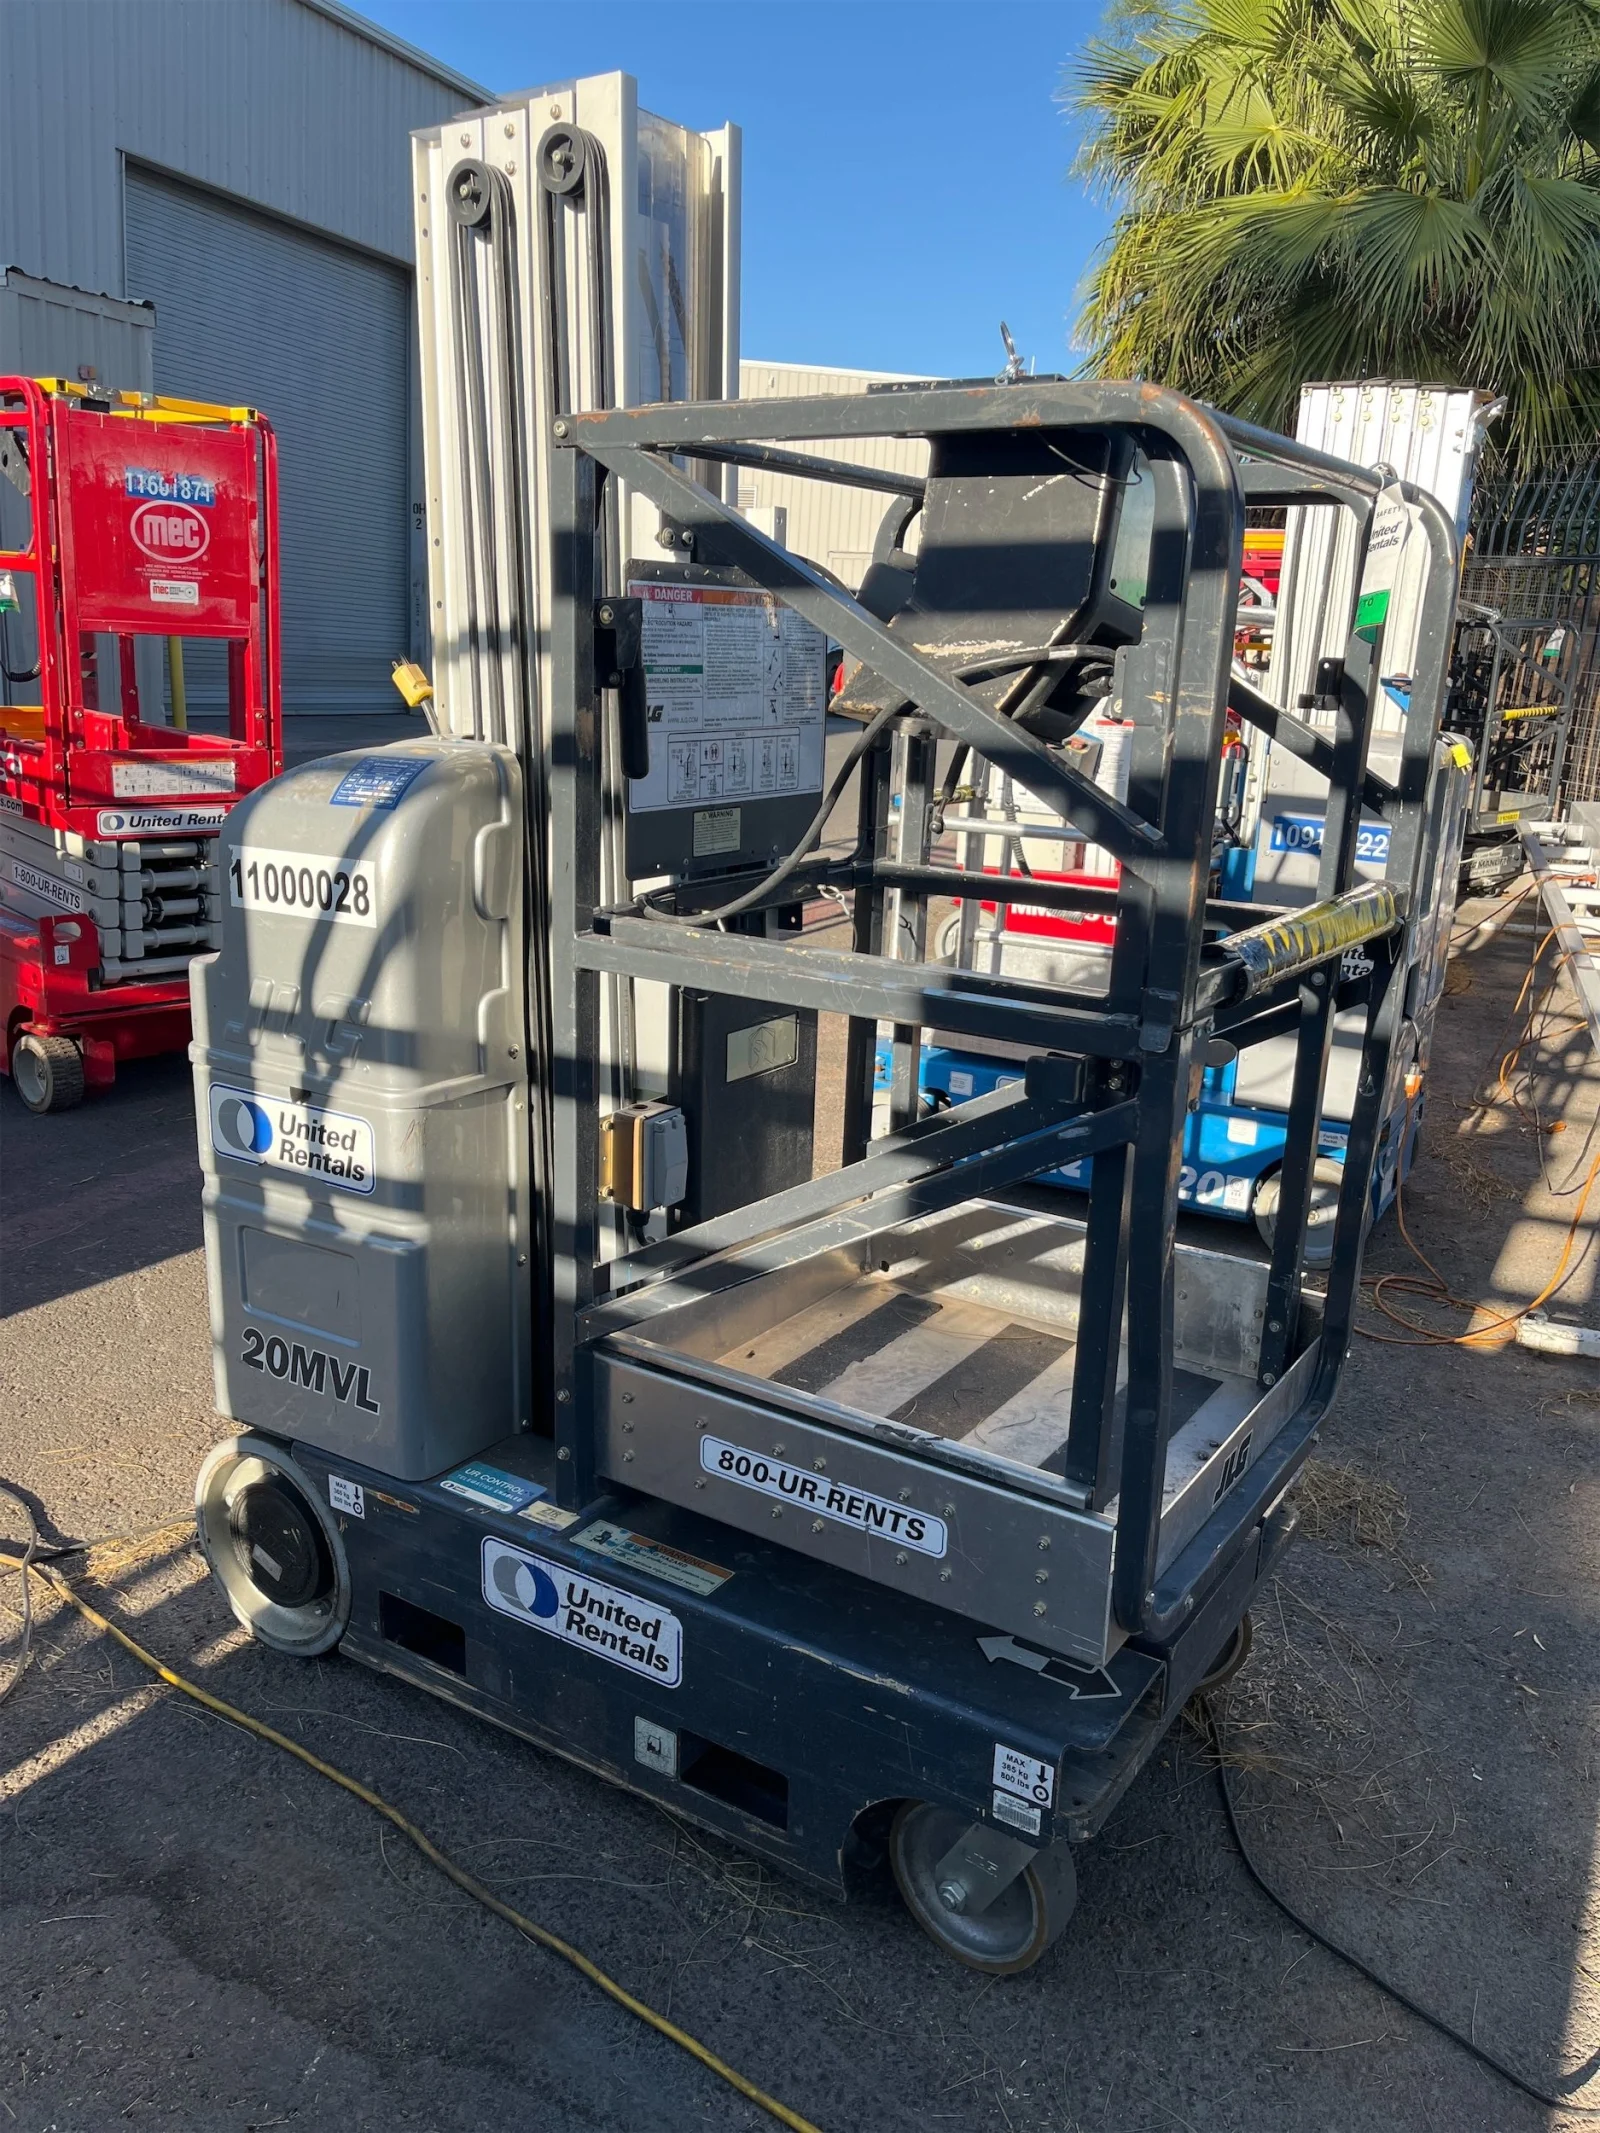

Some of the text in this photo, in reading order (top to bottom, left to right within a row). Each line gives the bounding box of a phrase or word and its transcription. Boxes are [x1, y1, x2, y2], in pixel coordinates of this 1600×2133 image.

[416, 518, 422, 530] 2
[1376, 505, 1401, 519] SAFETY
[143, 515, 199, 548] mec
[1367, 535, 1399, 552] entals
[654, 588, 692, 602] DANGER
[129, 814, 182, 828] United
[708, 809, 734, 819] WARNING
[14, 866, 82, 910] 1-800-UR-RENTS
[231, 858, 370, 917] 11000028
[278, 1111, 357, 1152] United
[278, 1139, 366, 1182] Rentals
[241, 1326, 381, 1415] 20MVL
[464, 1468, 481, 1478] UR
[480, 1474, 527, 1495] CONTROL
[1212, 1429, 1253, 1509] JLG
[456, 1473, 493, 1492] TELEMATICS
[493, 1487, 523, 1503] ENABLED
[718, 1449, 926, 1541] 800-UR-RENTS
[655, 1544, 706, 1569] WARNING
[660, 1554, 688, 1568] HAZARD
[566, 1583, 662, 1642] United
[565, 1609, 670, 1673] Rentals
[1001, 1761, 1029, 1781] 365 kg
[1006, 1754, 1026, 1768] MAX
[1000, 1771, 1030, 1790] 800 lbs
